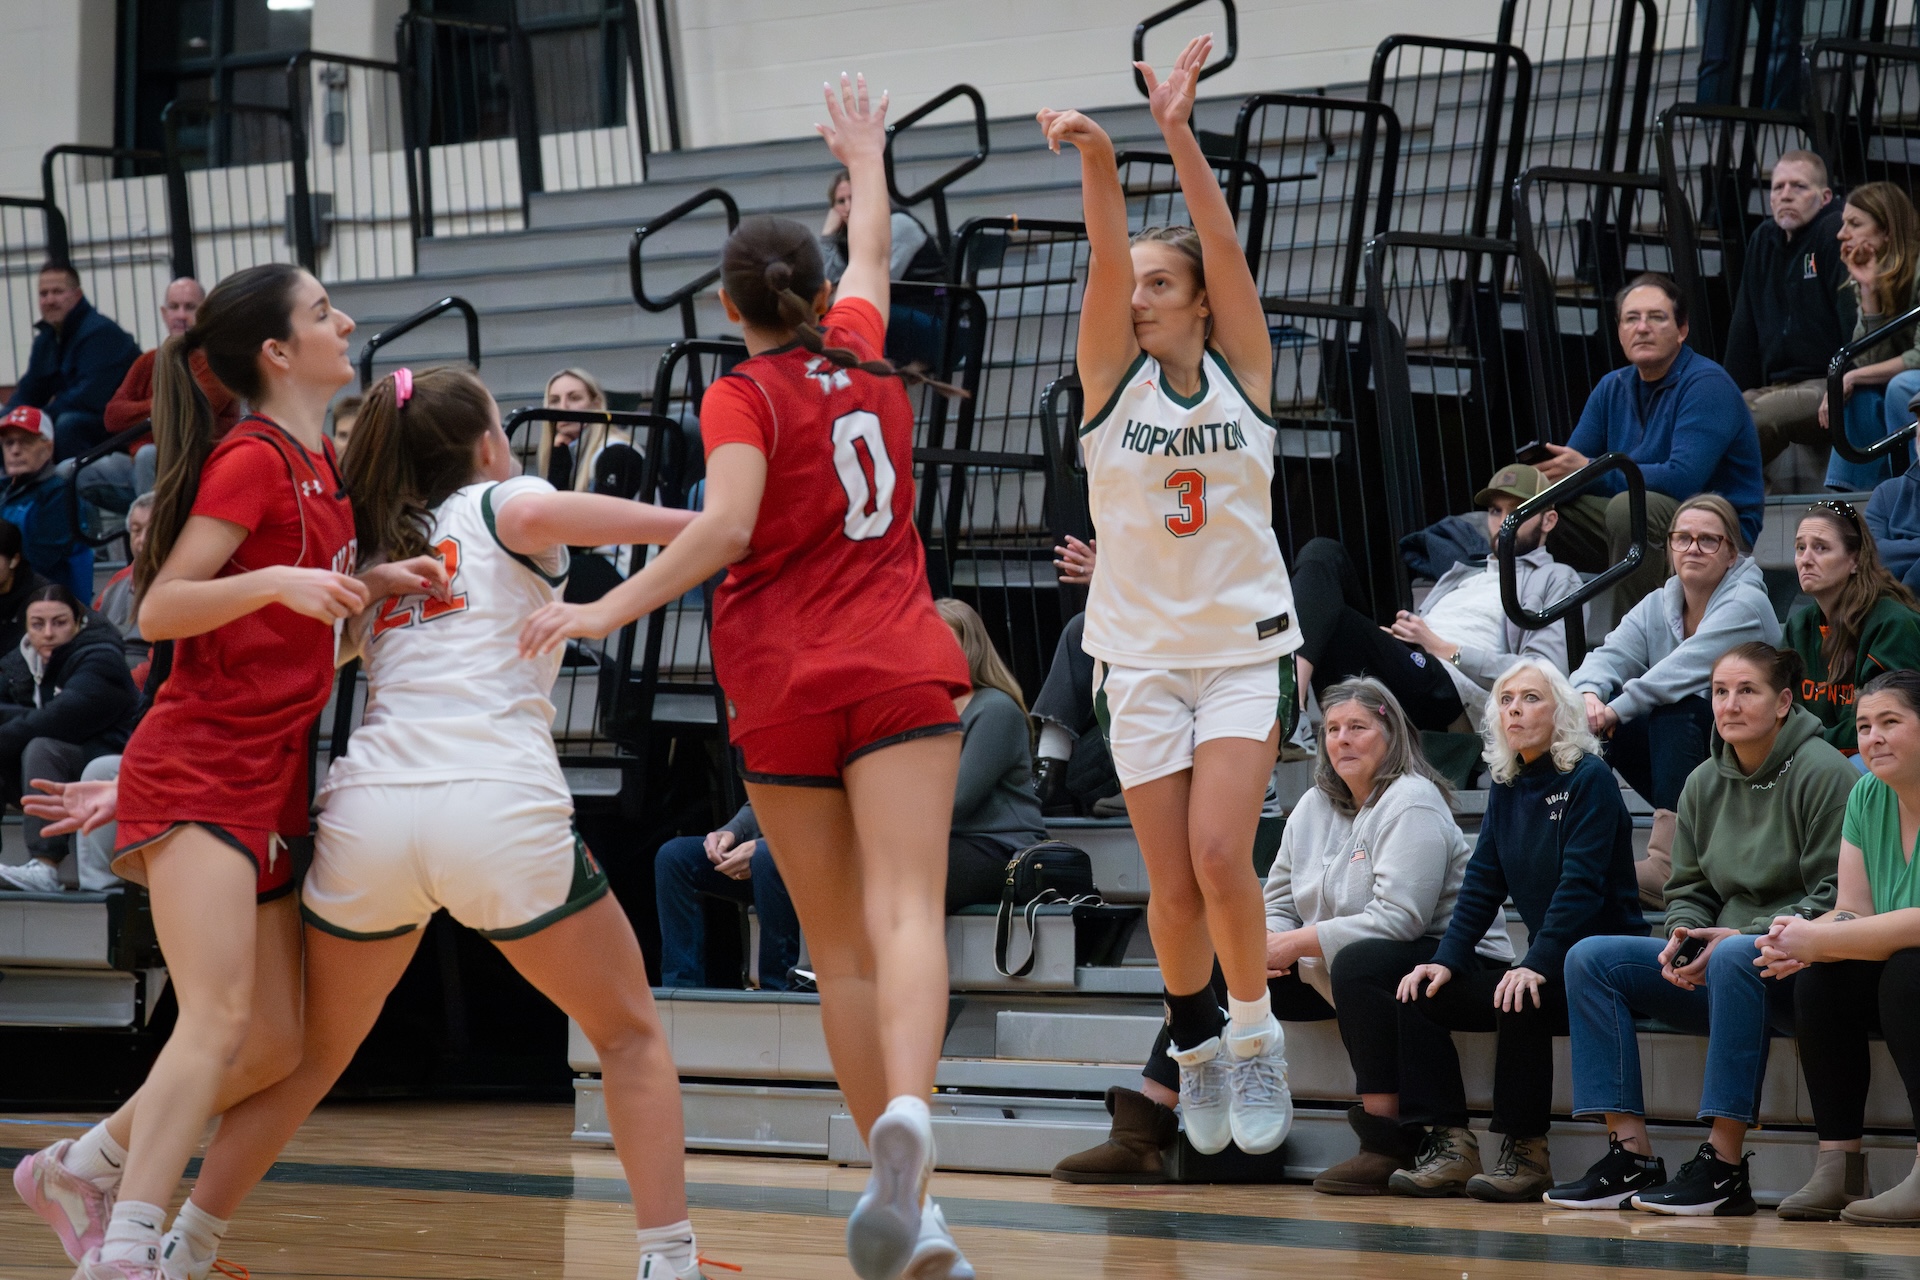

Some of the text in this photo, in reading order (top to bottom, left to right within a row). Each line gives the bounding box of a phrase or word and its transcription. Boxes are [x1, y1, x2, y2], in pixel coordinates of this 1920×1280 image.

[1121, 419, 1248, 457] HOPKINTON
[831, 408, 896, 541] 0
[1164, 468, 1207, 538] 3
